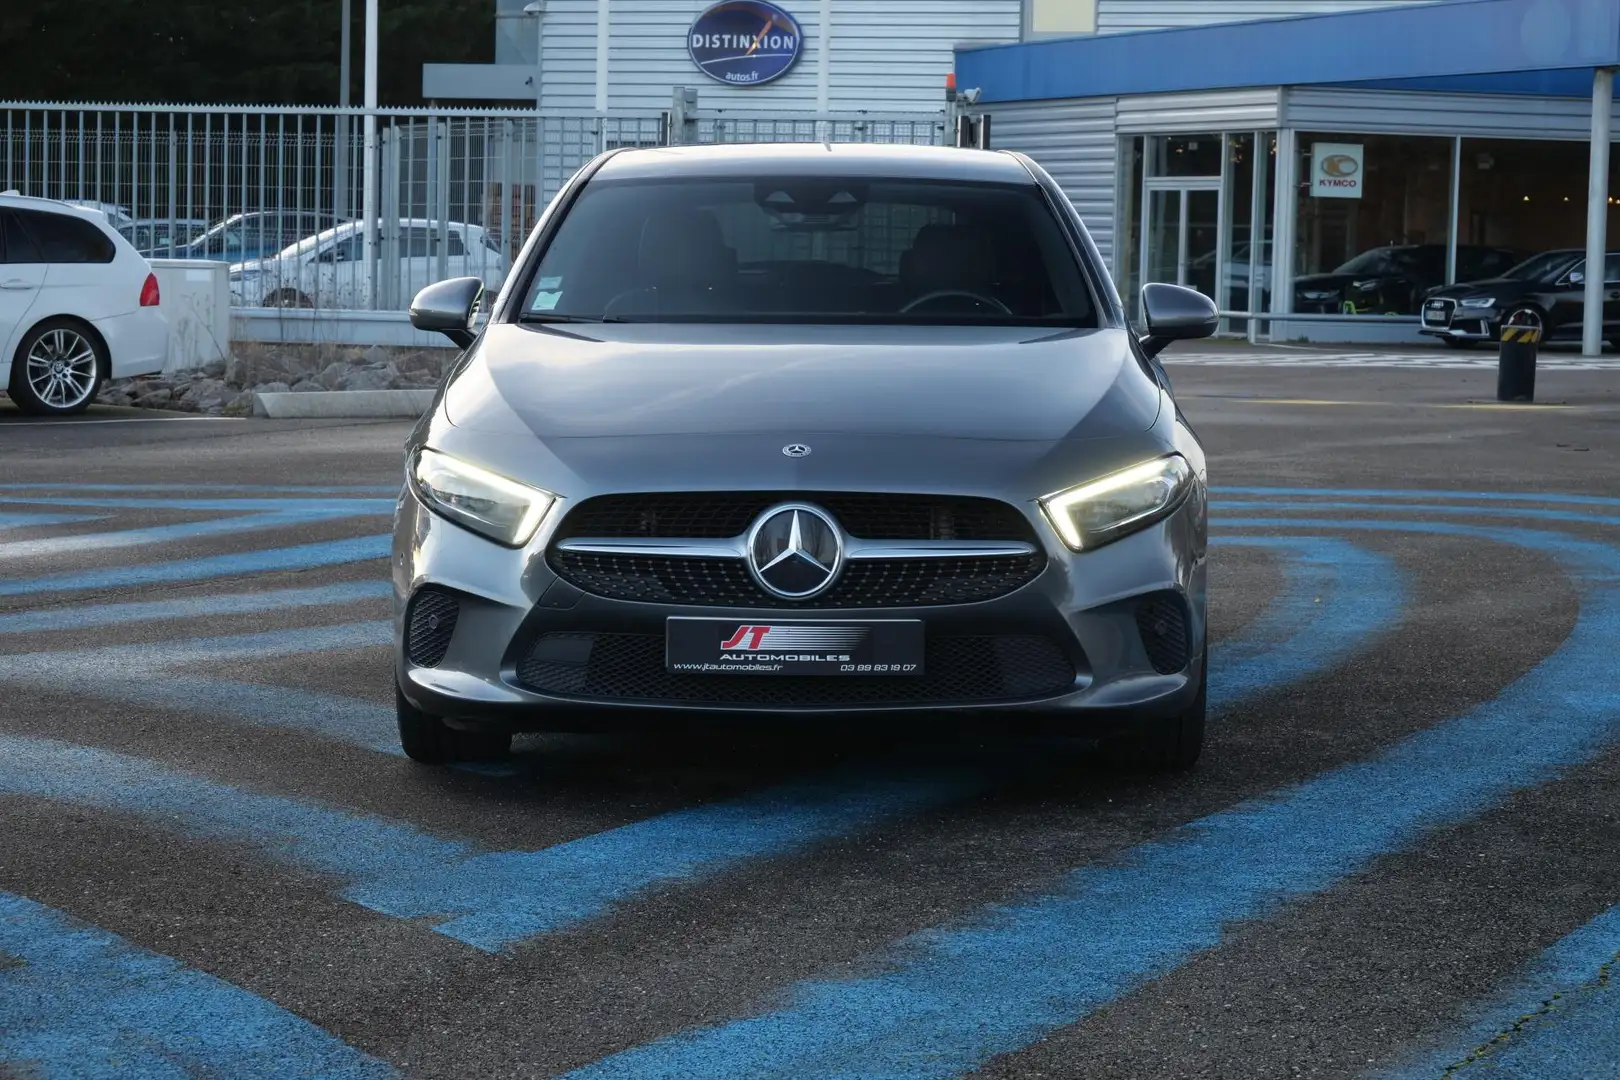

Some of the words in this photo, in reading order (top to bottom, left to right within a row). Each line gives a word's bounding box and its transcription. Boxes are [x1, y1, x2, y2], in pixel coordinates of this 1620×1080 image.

[692, 34, 794, 49] DISTINXION
[725, 71, 759, 82] autos.fr
[1319, 179, 1357, 188] KYMCO
[720, 625, 772, 651] JT
[719, 653, 850, 662] AUTOMOBILES
[673, 662, 783, 672] www.jtautomobiles.fr
